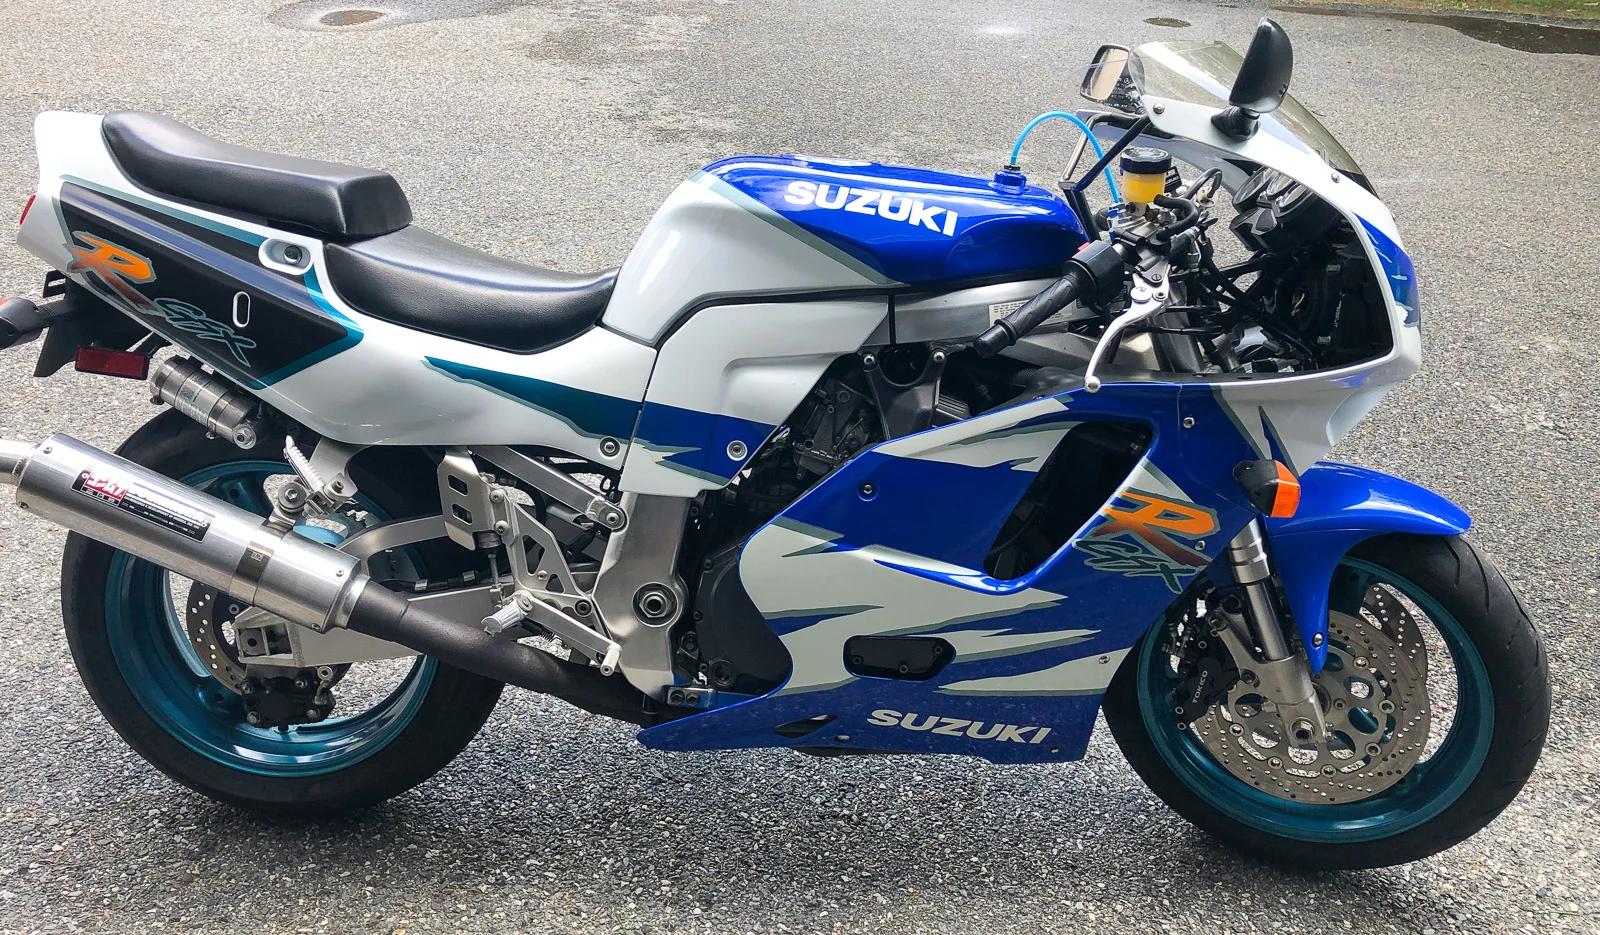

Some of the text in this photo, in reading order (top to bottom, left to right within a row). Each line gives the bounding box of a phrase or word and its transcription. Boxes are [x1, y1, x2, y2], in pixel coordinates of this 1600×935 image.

[784, 180, 958, 236] SUZUKI
[68, 231, 157, 315] R
[154, 298, 257, 367] GSX
[1084, 487, 1221, 569] R
[1071, 538, 1198, 594] GSX
[1192, 670, 1208, 704] TOKICO
[866, 709, 1052, 744] SUZUKI
